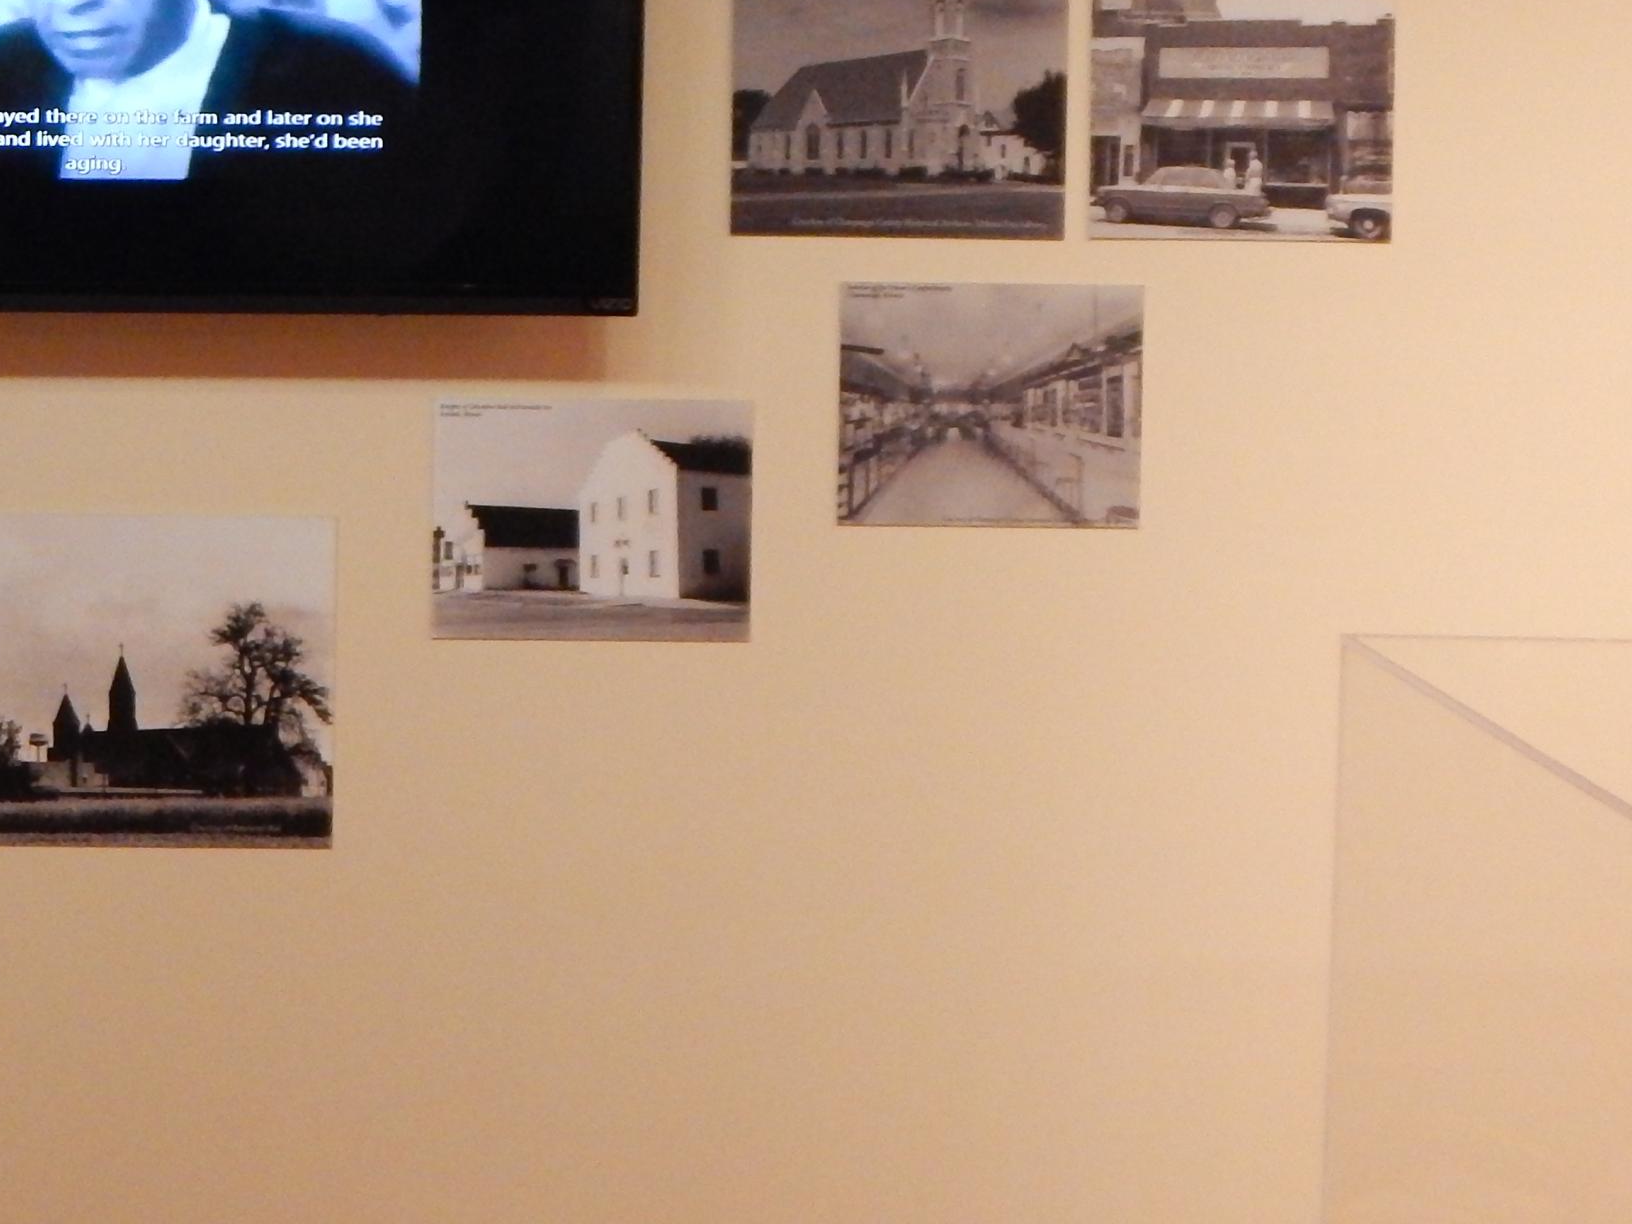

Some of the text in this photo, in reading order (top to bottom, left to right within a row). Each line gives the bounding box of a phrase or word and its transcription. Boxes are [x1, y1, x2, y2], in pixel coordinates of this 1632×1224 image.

[46, 108, 97, 125] there
[103, 111, 130, 125] on
[135, 109, 168, 125] the
[174, 109, 218, 125] farm
[223, 109, 262, 126] and
[266, 109, 313, 126] later
[316, 112, 343, 126] on
[348, 111, 384, 126] she
[36, 130, 84, 147] lived
[89, 131, 132, 147] with
[137, 131, 170, 147] her
[175, 132, 270, 152] daughter,
[275, 133, 328, 149] she'd
[333, 133, 384, 149] been
